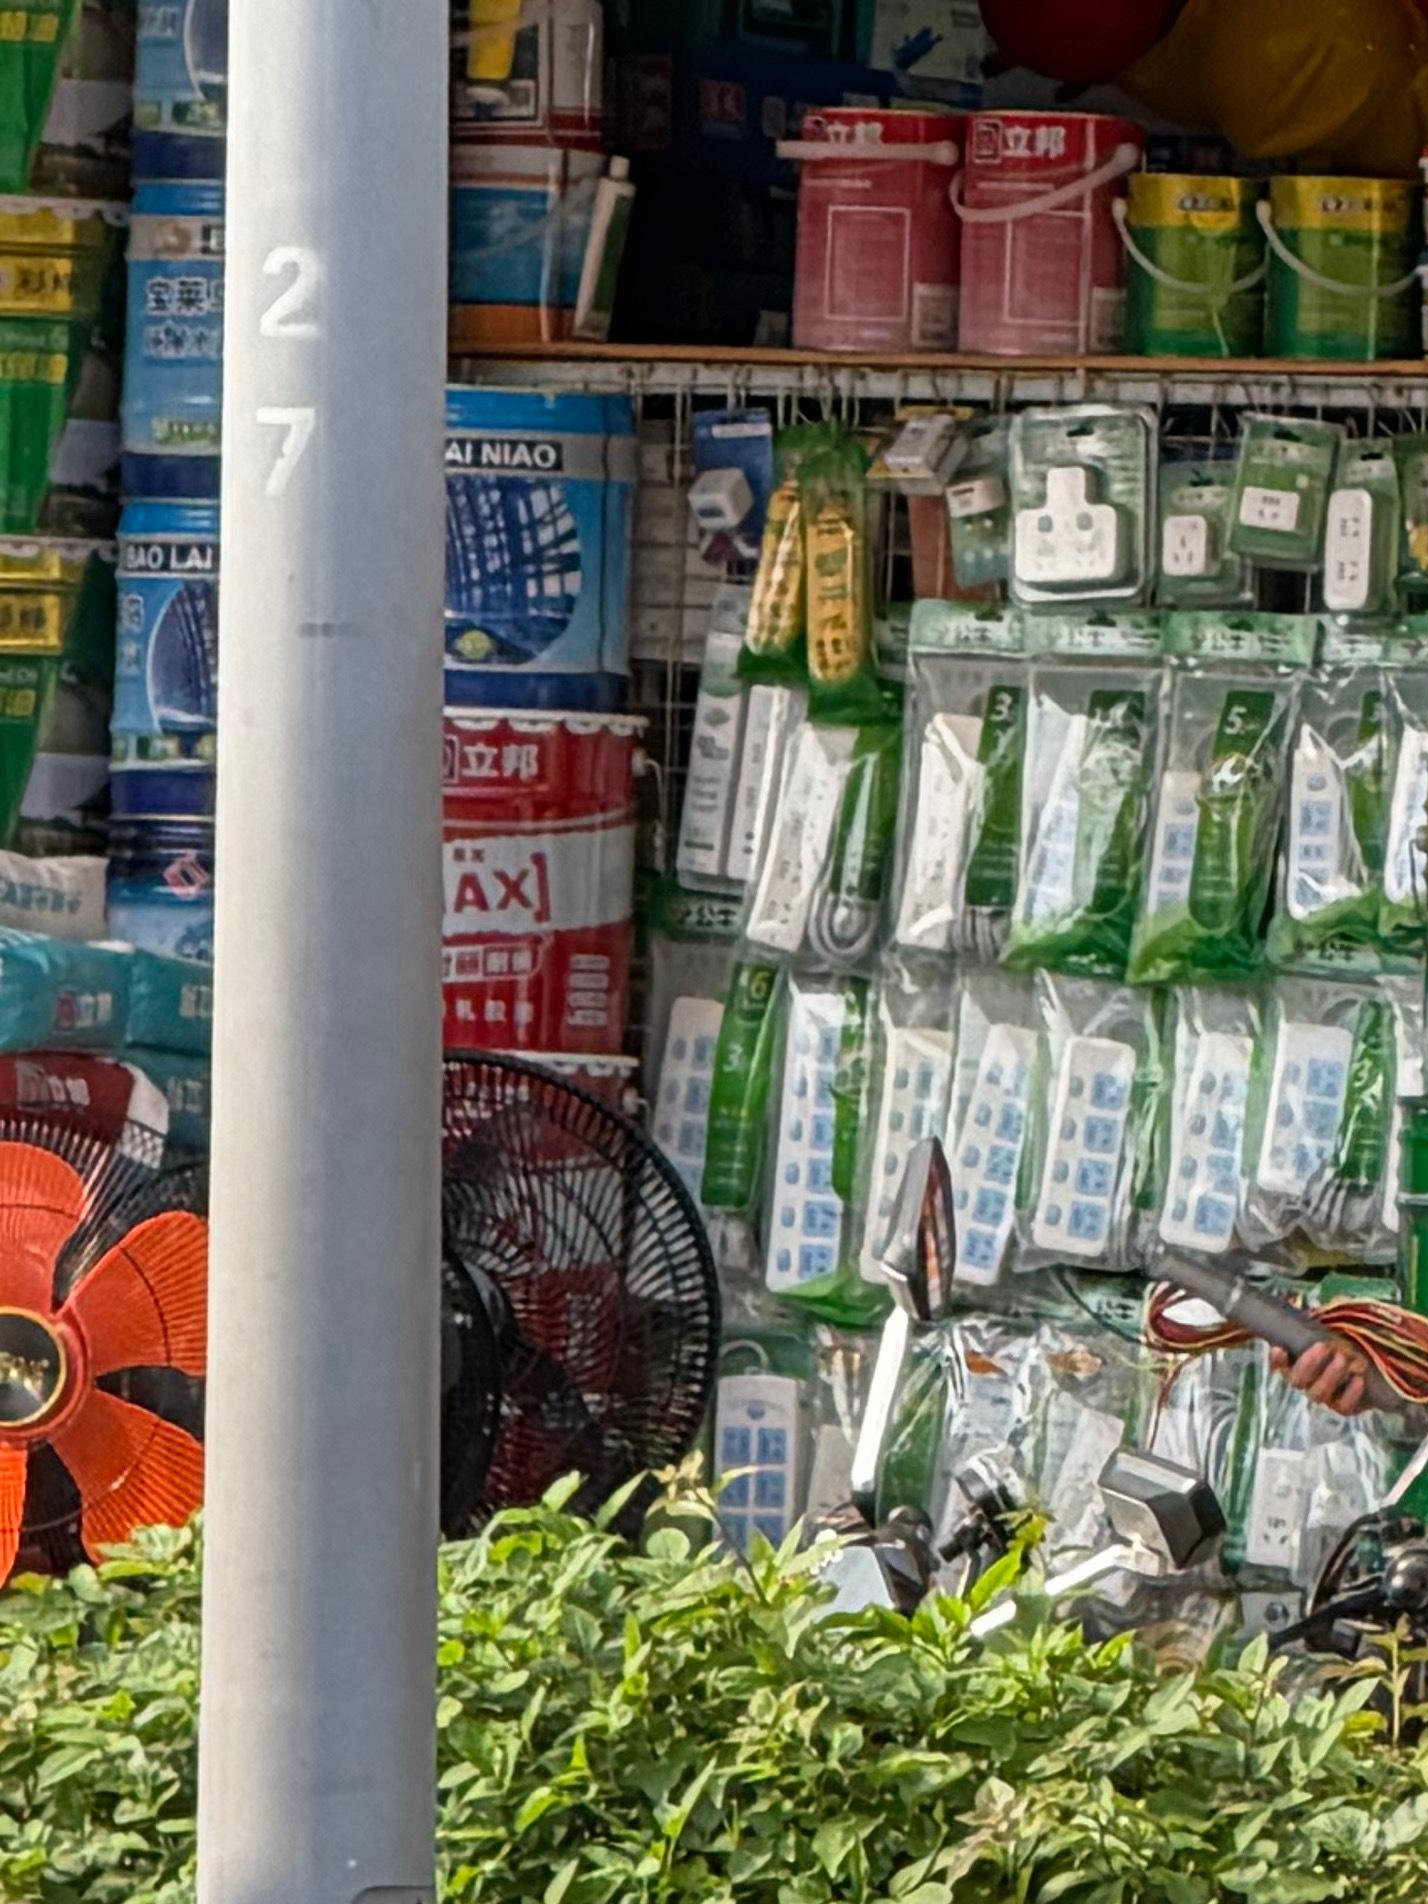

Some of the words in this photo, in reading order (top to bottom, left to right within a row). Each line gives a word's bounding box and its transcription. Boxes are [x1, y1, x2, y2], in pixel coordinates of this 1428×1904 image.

[1002, 125, 1066, 157] 立邦
[260, 246, 322, 337] 2
[256, 406, 316, 495] 7
[481, 443, 557, 469] NIAO
[462, 742, 538, 782] 立邦
